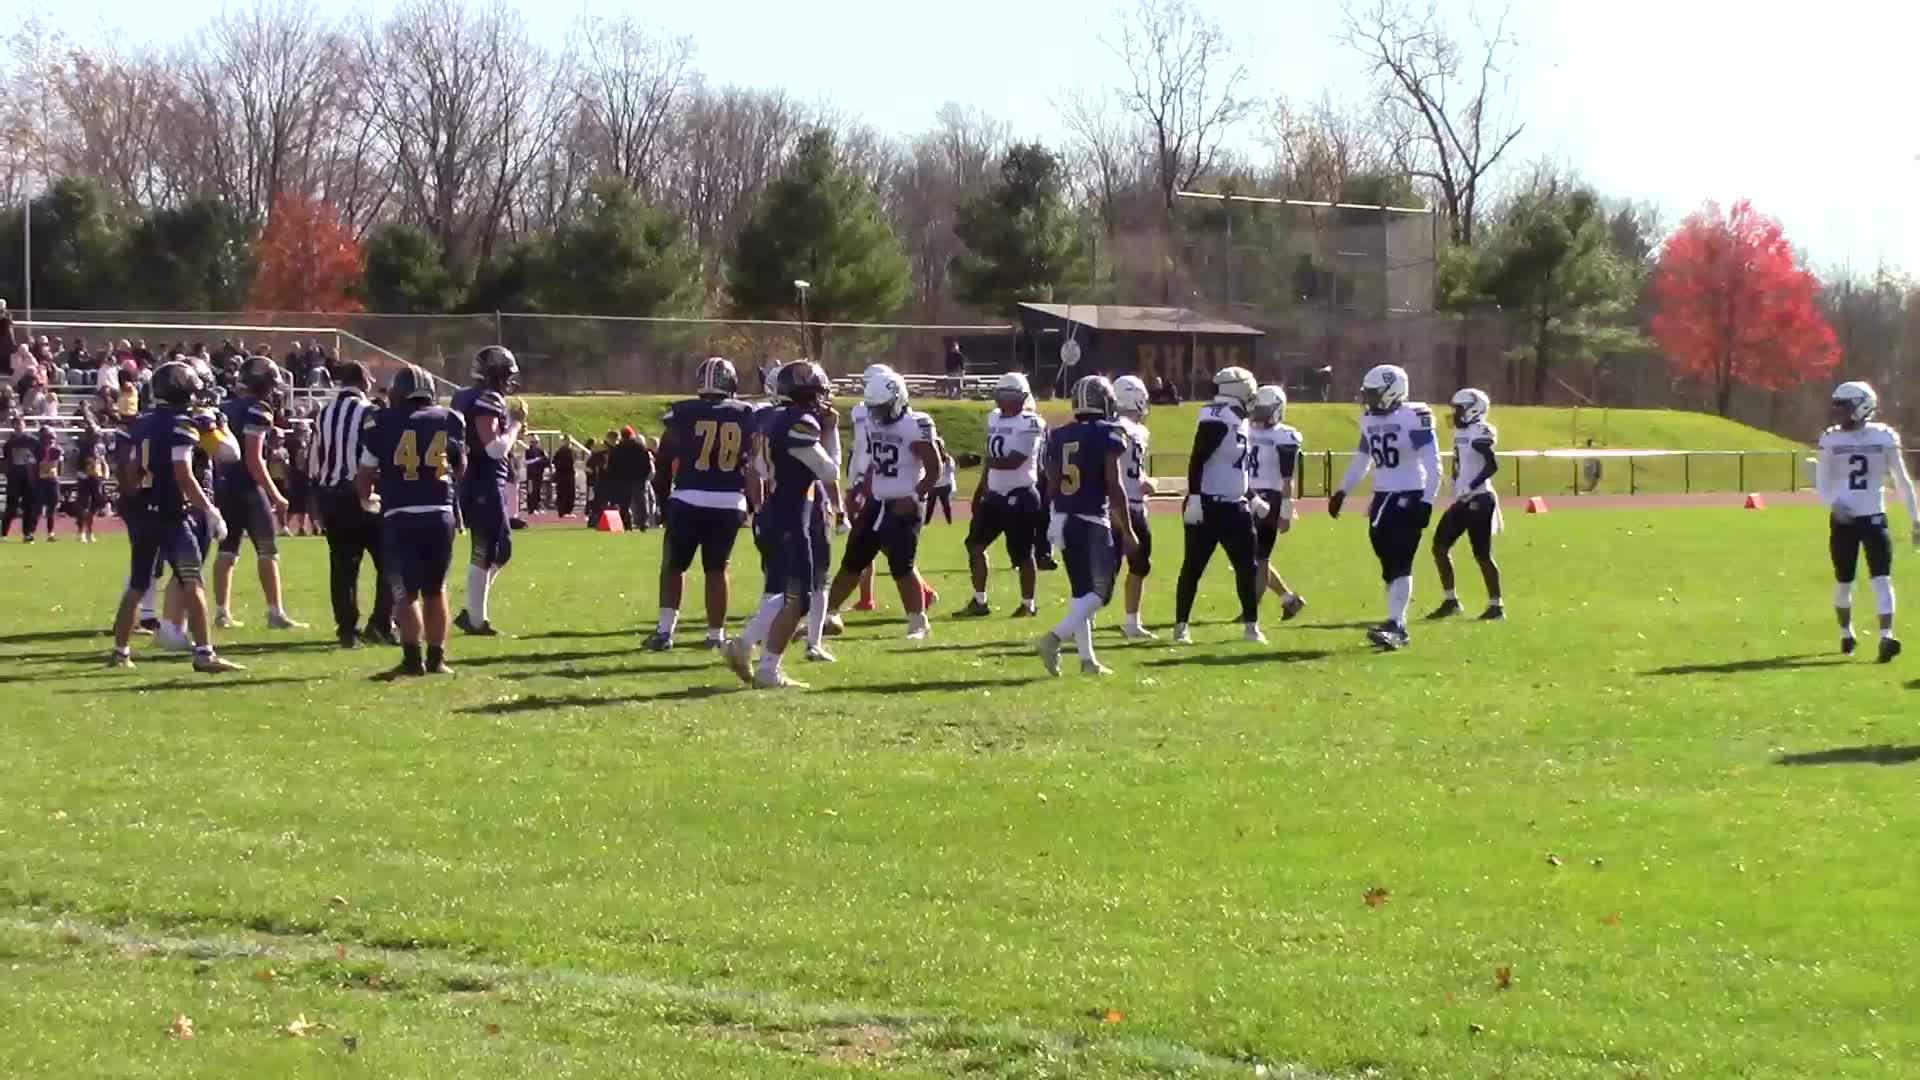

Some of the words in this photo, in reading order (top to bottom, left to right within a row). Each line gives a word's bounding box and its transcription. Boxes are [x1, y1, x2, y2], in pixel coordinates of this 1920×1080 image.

[393, 429, 449, 480] 44
[695, 420, 741, 471] 78
[1061, 441, 1081, 495] 5
[1370, 432, 1399, 468] 66
[1848, 454, 1869, 490] 2
